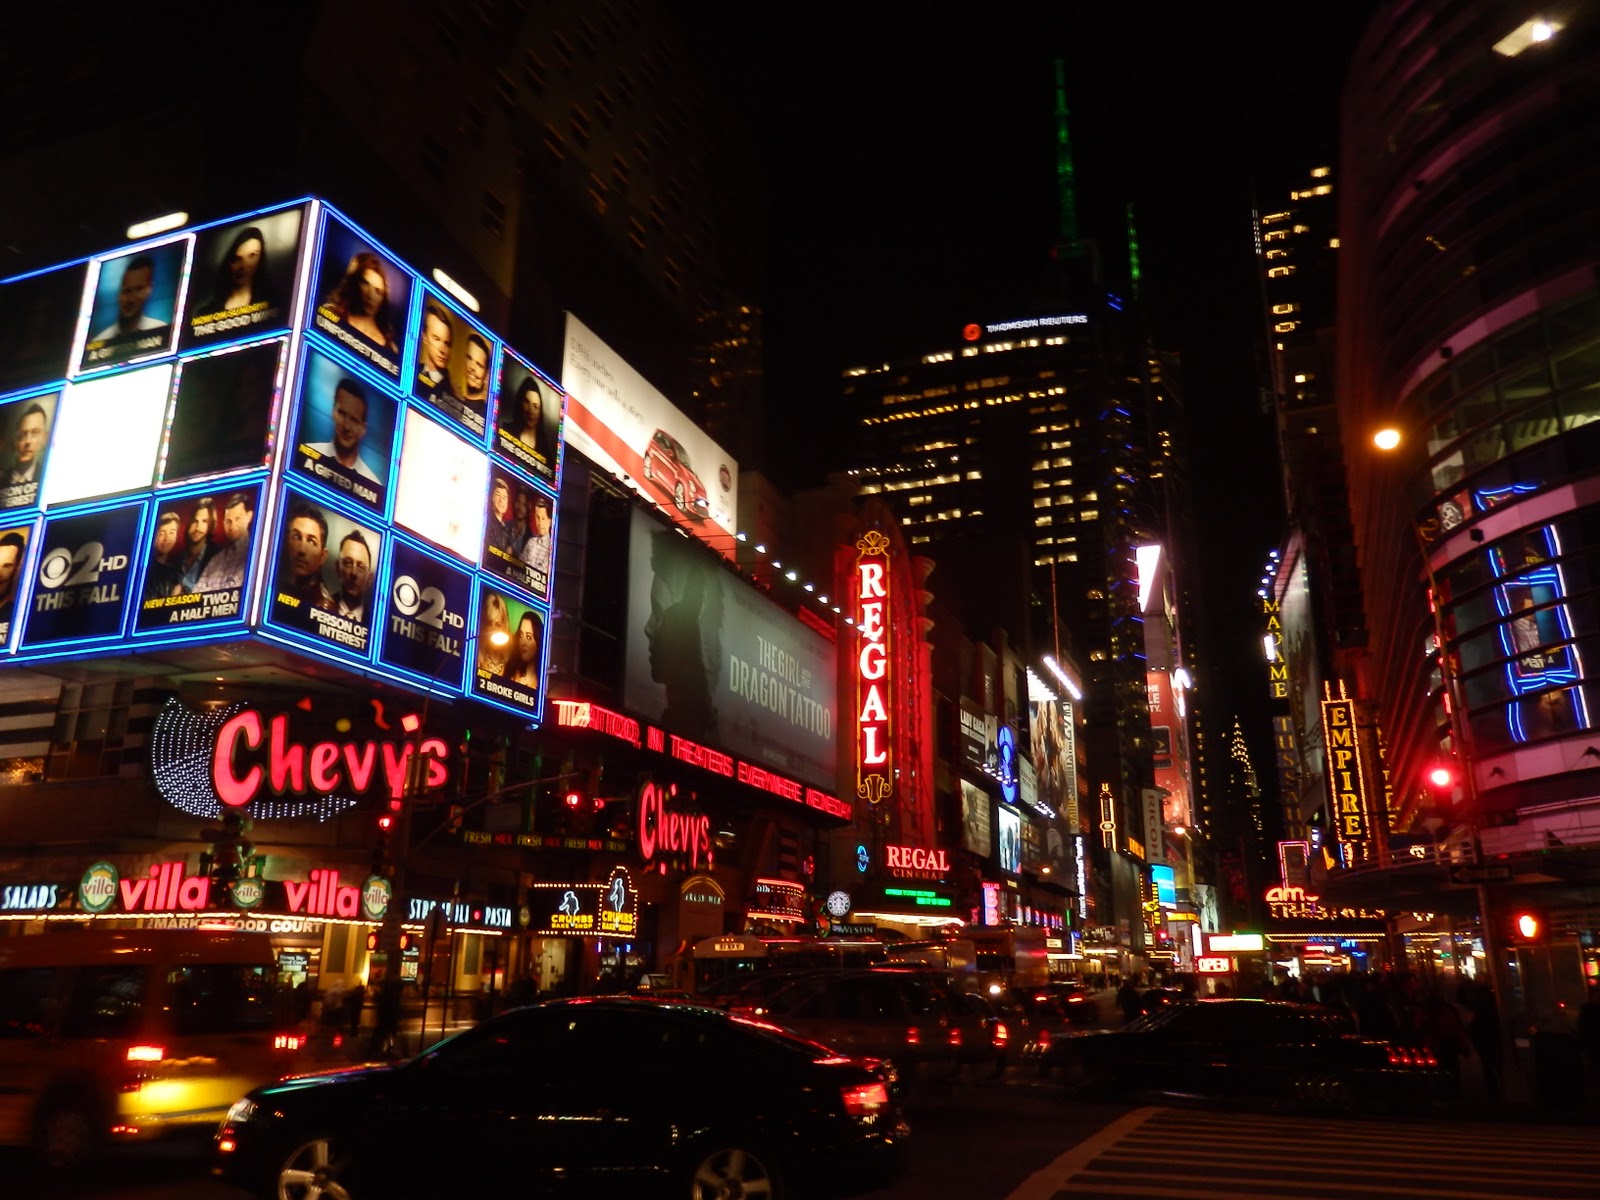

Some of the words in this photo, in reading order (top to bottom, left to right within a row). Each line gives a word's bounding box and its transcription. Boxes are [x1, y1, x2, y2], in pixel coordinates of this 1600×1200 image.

[216, 316, 250, 331] GOOD
[985, 319, 1039, 333] THOMSON
[1039, 314, 1088, 326] REUTERS
[316, 314, 400, 376] UNFORGETTABLE
[303, 458, 315, 472] A
[314, 463, 353, 490] GIFTED
[352, 482, 378, 504] MAN
[99, 554, 128, 573] HD
[36, 591, 76, 612] THIS
[78, 584, 121, 607] FALL
[143, 600, 164, 610] NEW
[164, 593, 201, 608] SEASON
[202, 592, 230, 607] TWO
[230, 590, 240, 601] &
[277, 592, 301, 608] NEW
[169, 612, 179, 623] A
[180, 607, 211, 620] HALF
[211, 602, 238, 617] MEN
[309, 607, 353, 634] PERSON
[353, 625, 368, 638] OF
[441, 609, 465, 629] HD
[318, 624, 367, 650] INTEREST
[391, 615, 425, 640] THIS
[1263, 599, 1288, 698] MADAME
[757, 635, 778, 673] THE
[777, 649, 802, 688] GIRL
[858, 563, 888, 765] REGAL
[477, 668, 492, 680] NEW
[479, 678, 487, 690] 2
[486, 683, 514, 699] BROKE
[513, 692, 535, 707] GIRLS
[729, 654, 788, 718] DRAGON
[788, 687, 831, 741] TATTOO
[669, 733, 734, 778] THEATERS
[1330, 707, 1362, 836] EMPIRE
[641, 782, 710, 870] Chevys
[1147, 794, 1160, 858] RICOH
[464, 831, 492, 844] FRESH
[564, 838, 586, 848] FRESH
[588, 839, 603, 850] MEX
[885, 846, 950, 871] REGAL
[893, 868, 945, 880] CINEMAS
[2, 885, 58, 910] SALADS
[82, 878, 116, 896] villa
[120, 862, 210, 911] villa
[234, 886, 262, 899] villa
[285, 870, 361, 917] villa
[365, 888, 390, 905] villa
[270, 920, 325, 934] COURT
[485, 906, 512, 928] PASTA
[551, 914, 594, 924] CRUMBS
[602, 910, 634, 925] CRUMBS
[845, 924, 875, 935] WESTIN
[1197, 958, 1229, 972] OPEN
